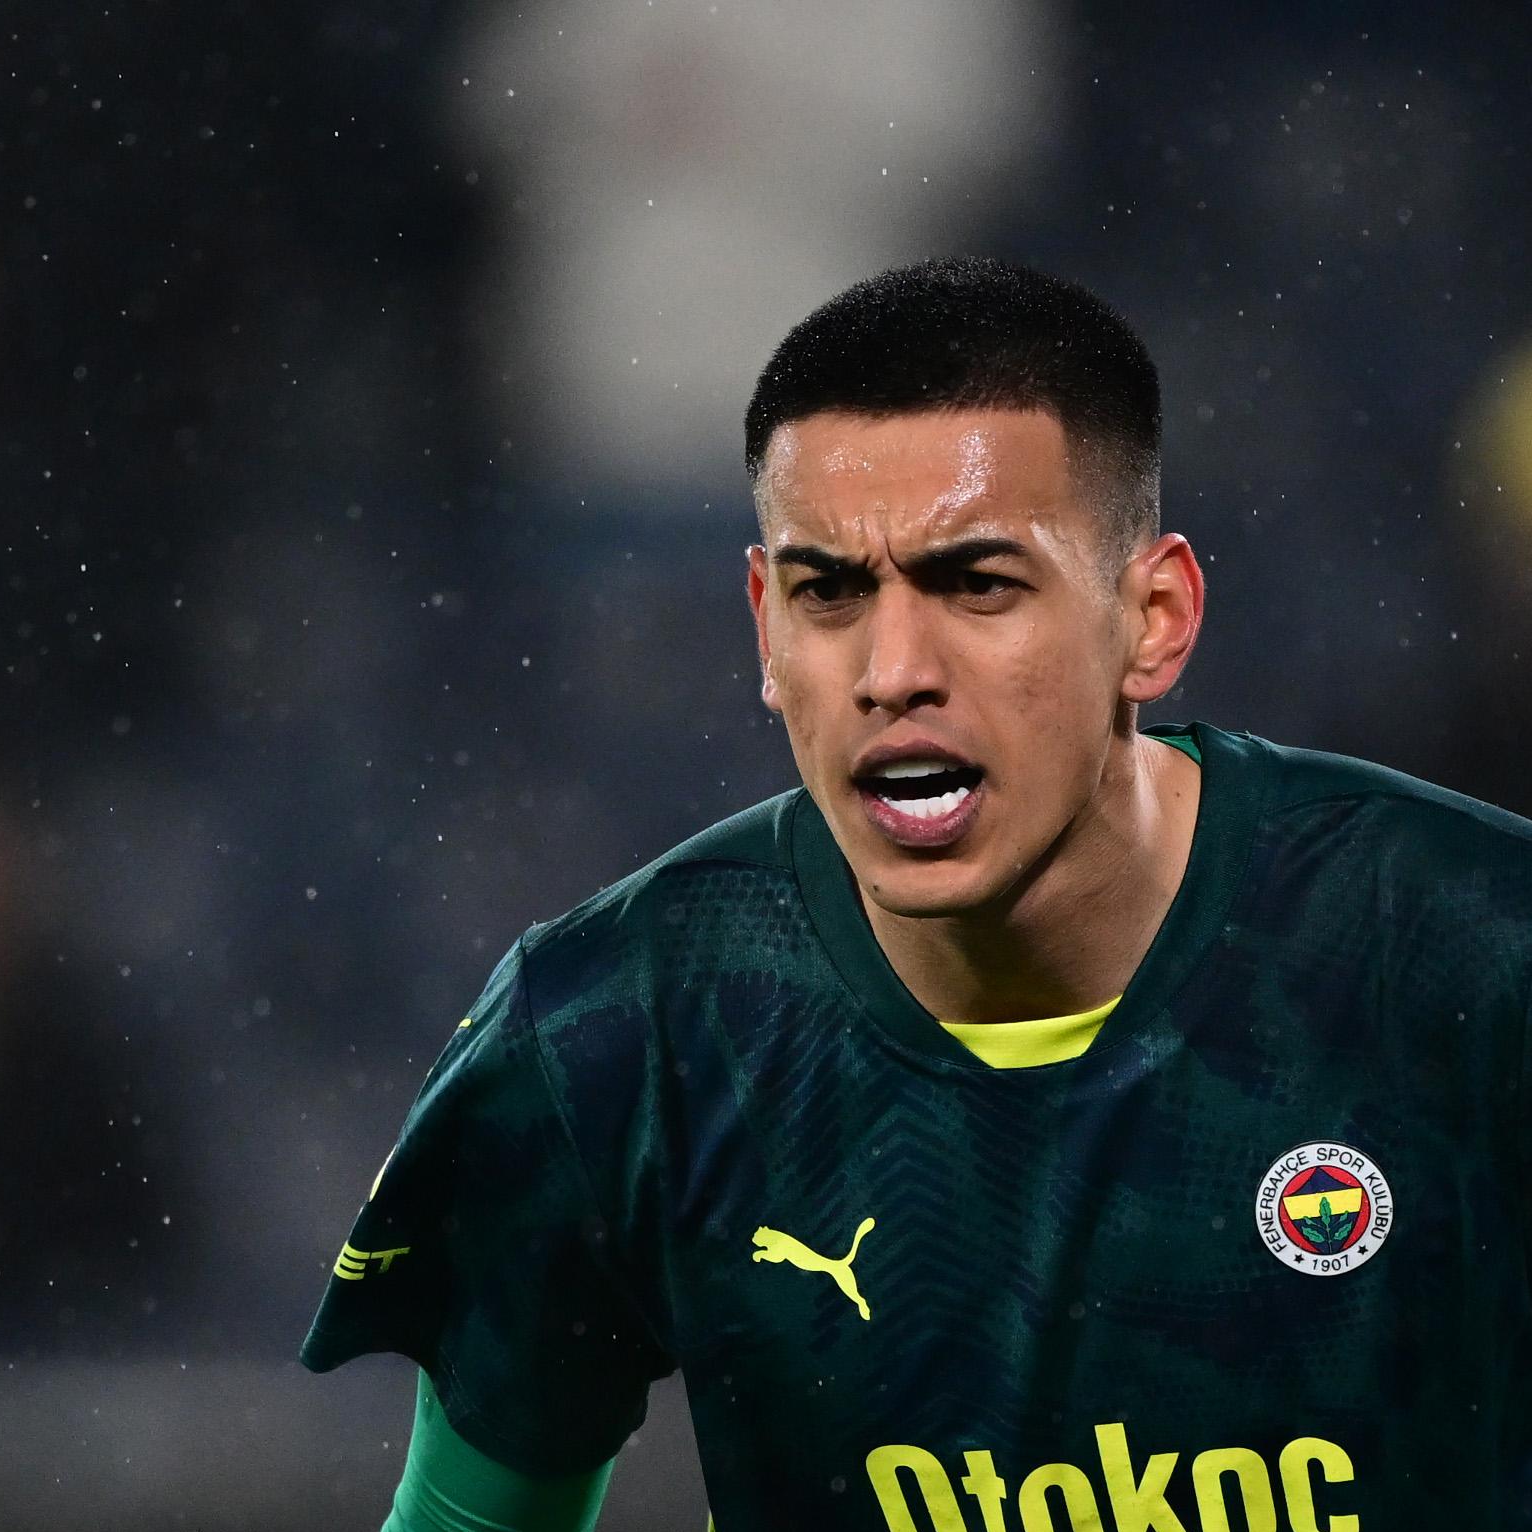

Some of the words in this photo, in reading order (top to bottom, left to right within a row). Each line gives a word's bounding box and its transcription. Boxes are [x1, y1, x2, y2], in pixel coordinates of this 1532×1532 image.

[1259, 1150, 1310, 1253] FENERBAHÇE
[1316, 1147, 1365, 1173] SPOR
[1364, 1172, 1393, 1240] KULÜBÜ
[1312, 1254, 1350, 1273] 1907
